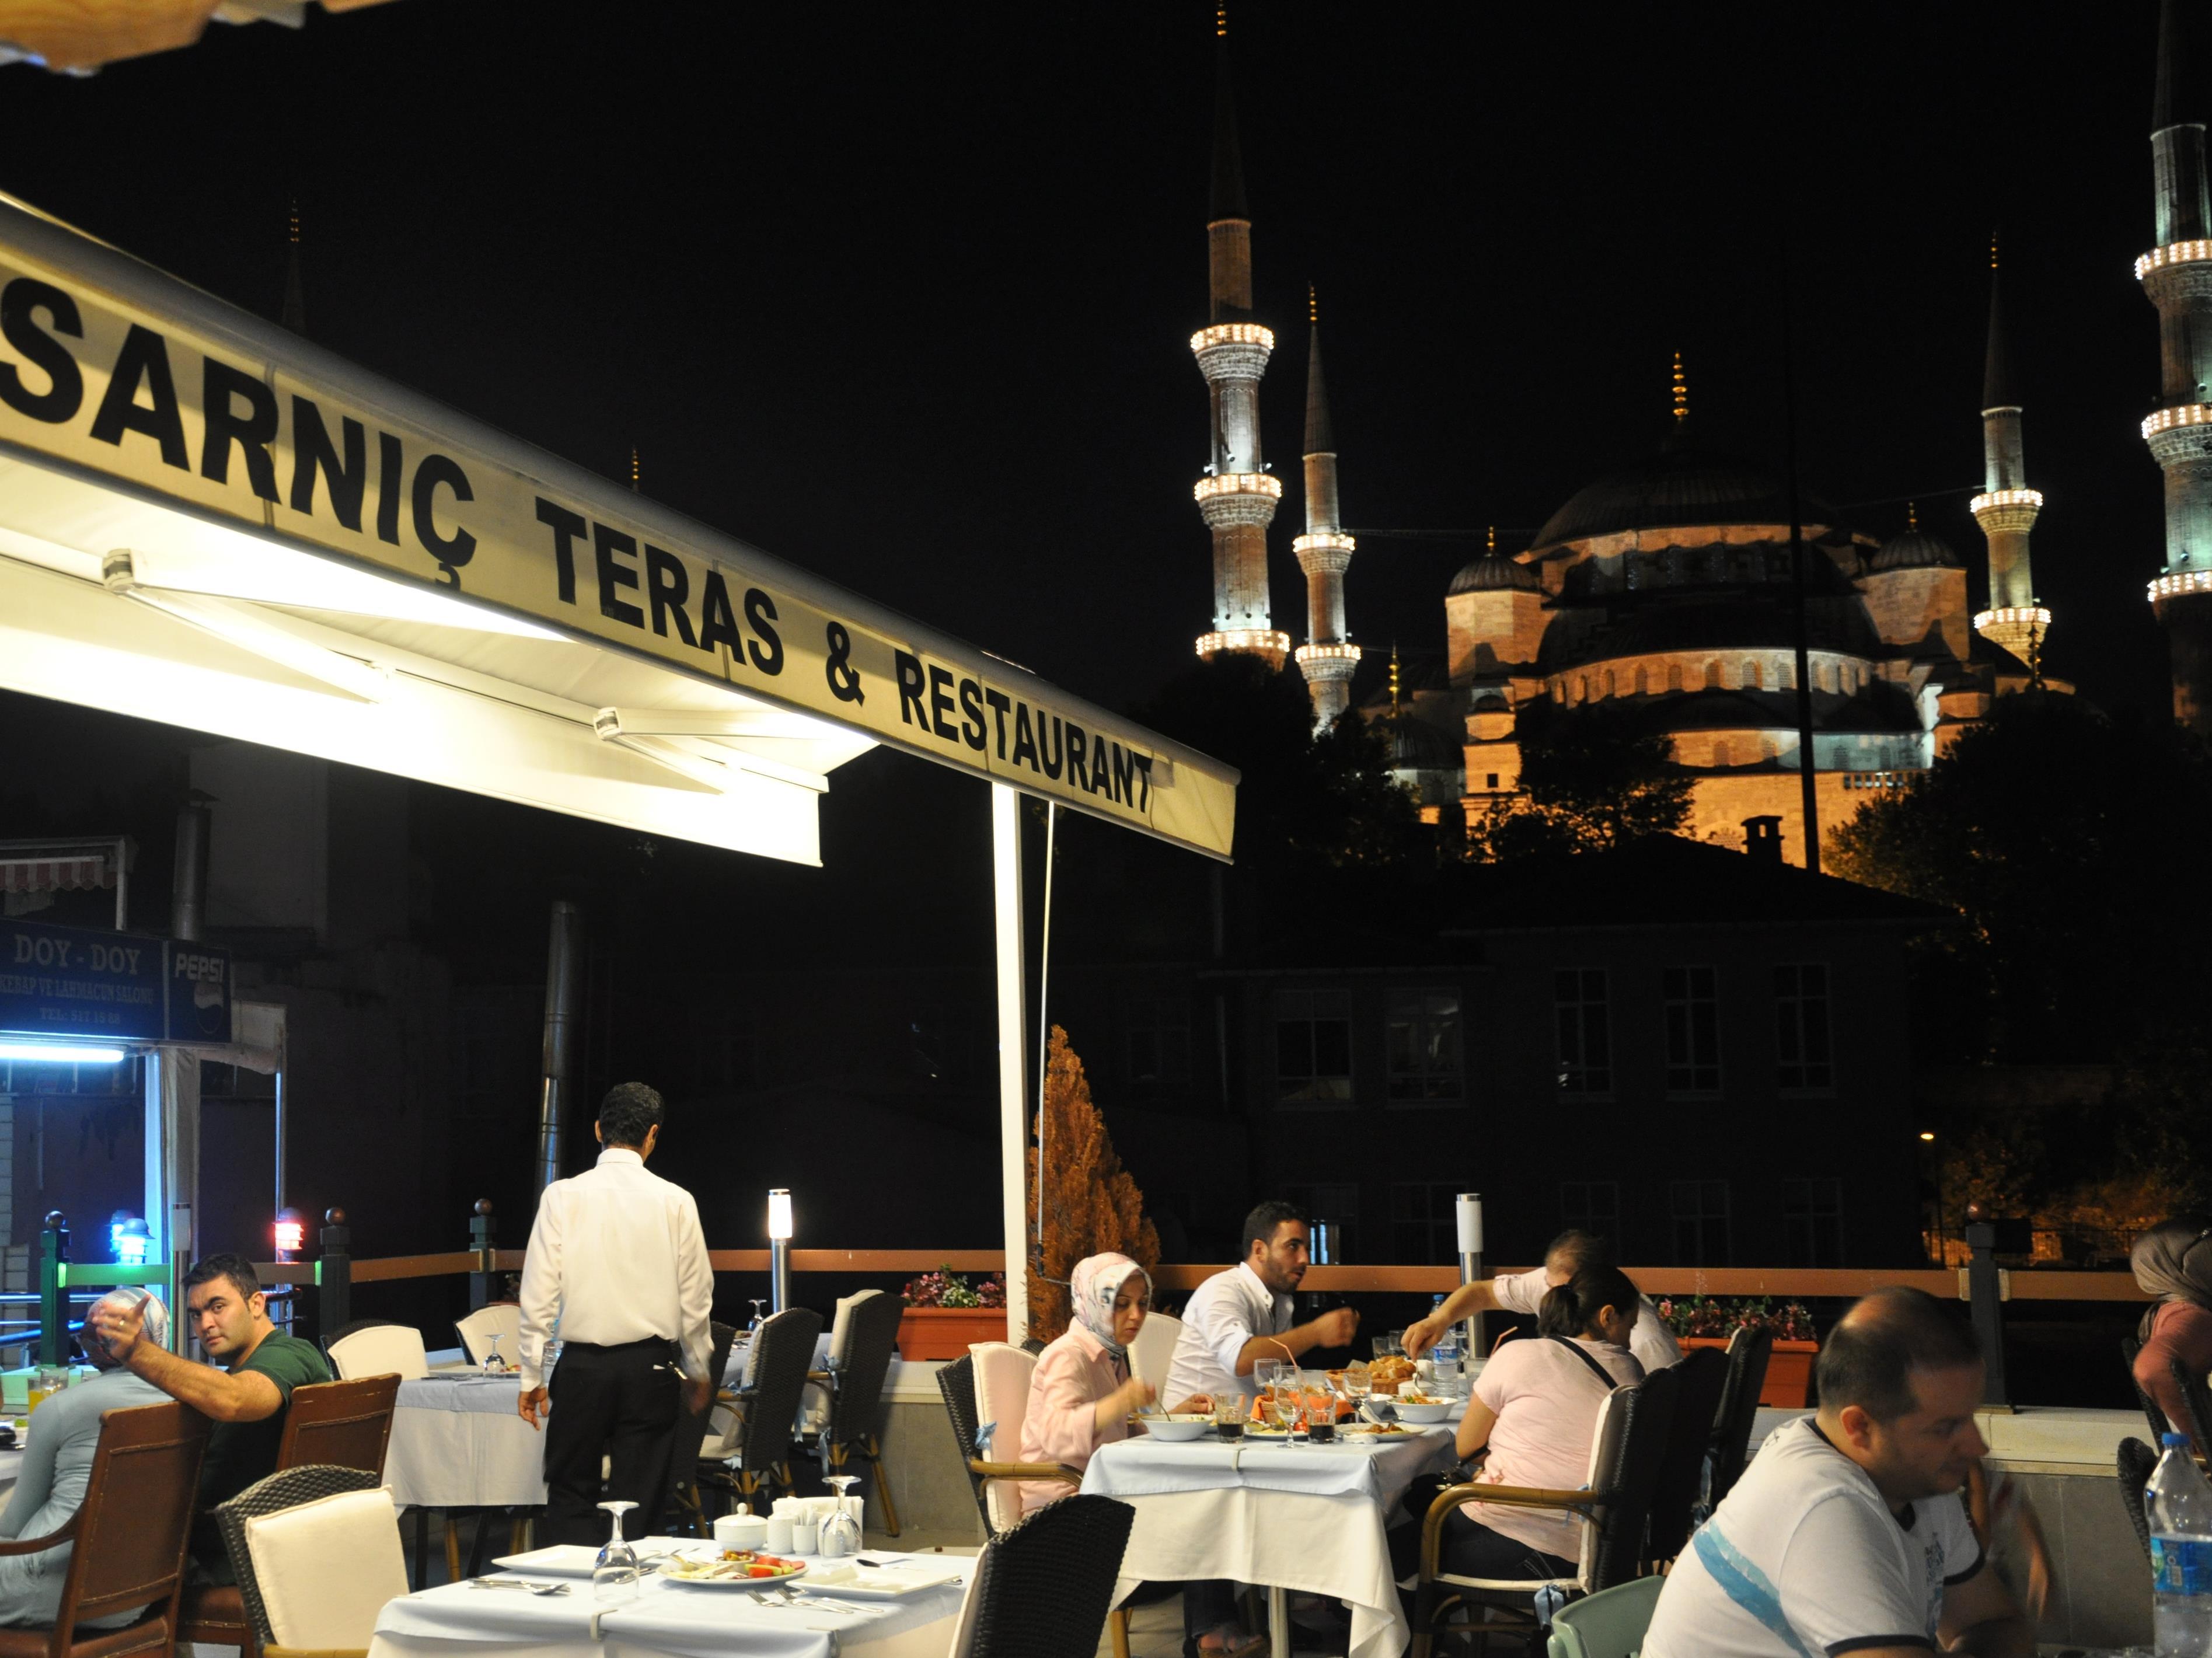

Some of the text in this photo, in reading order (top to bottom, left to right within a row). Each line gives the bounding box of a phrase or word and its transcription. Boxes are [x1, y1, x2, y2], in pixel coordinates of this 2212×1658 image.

[0, 277, 1153, 814] SARNIÇ TERAS & RESTAURANT
[175, 952, 224, 983] PEPSI
[39, 977, 53, 997] VE
[55, 979, 114, 1001] LAHMACUN
